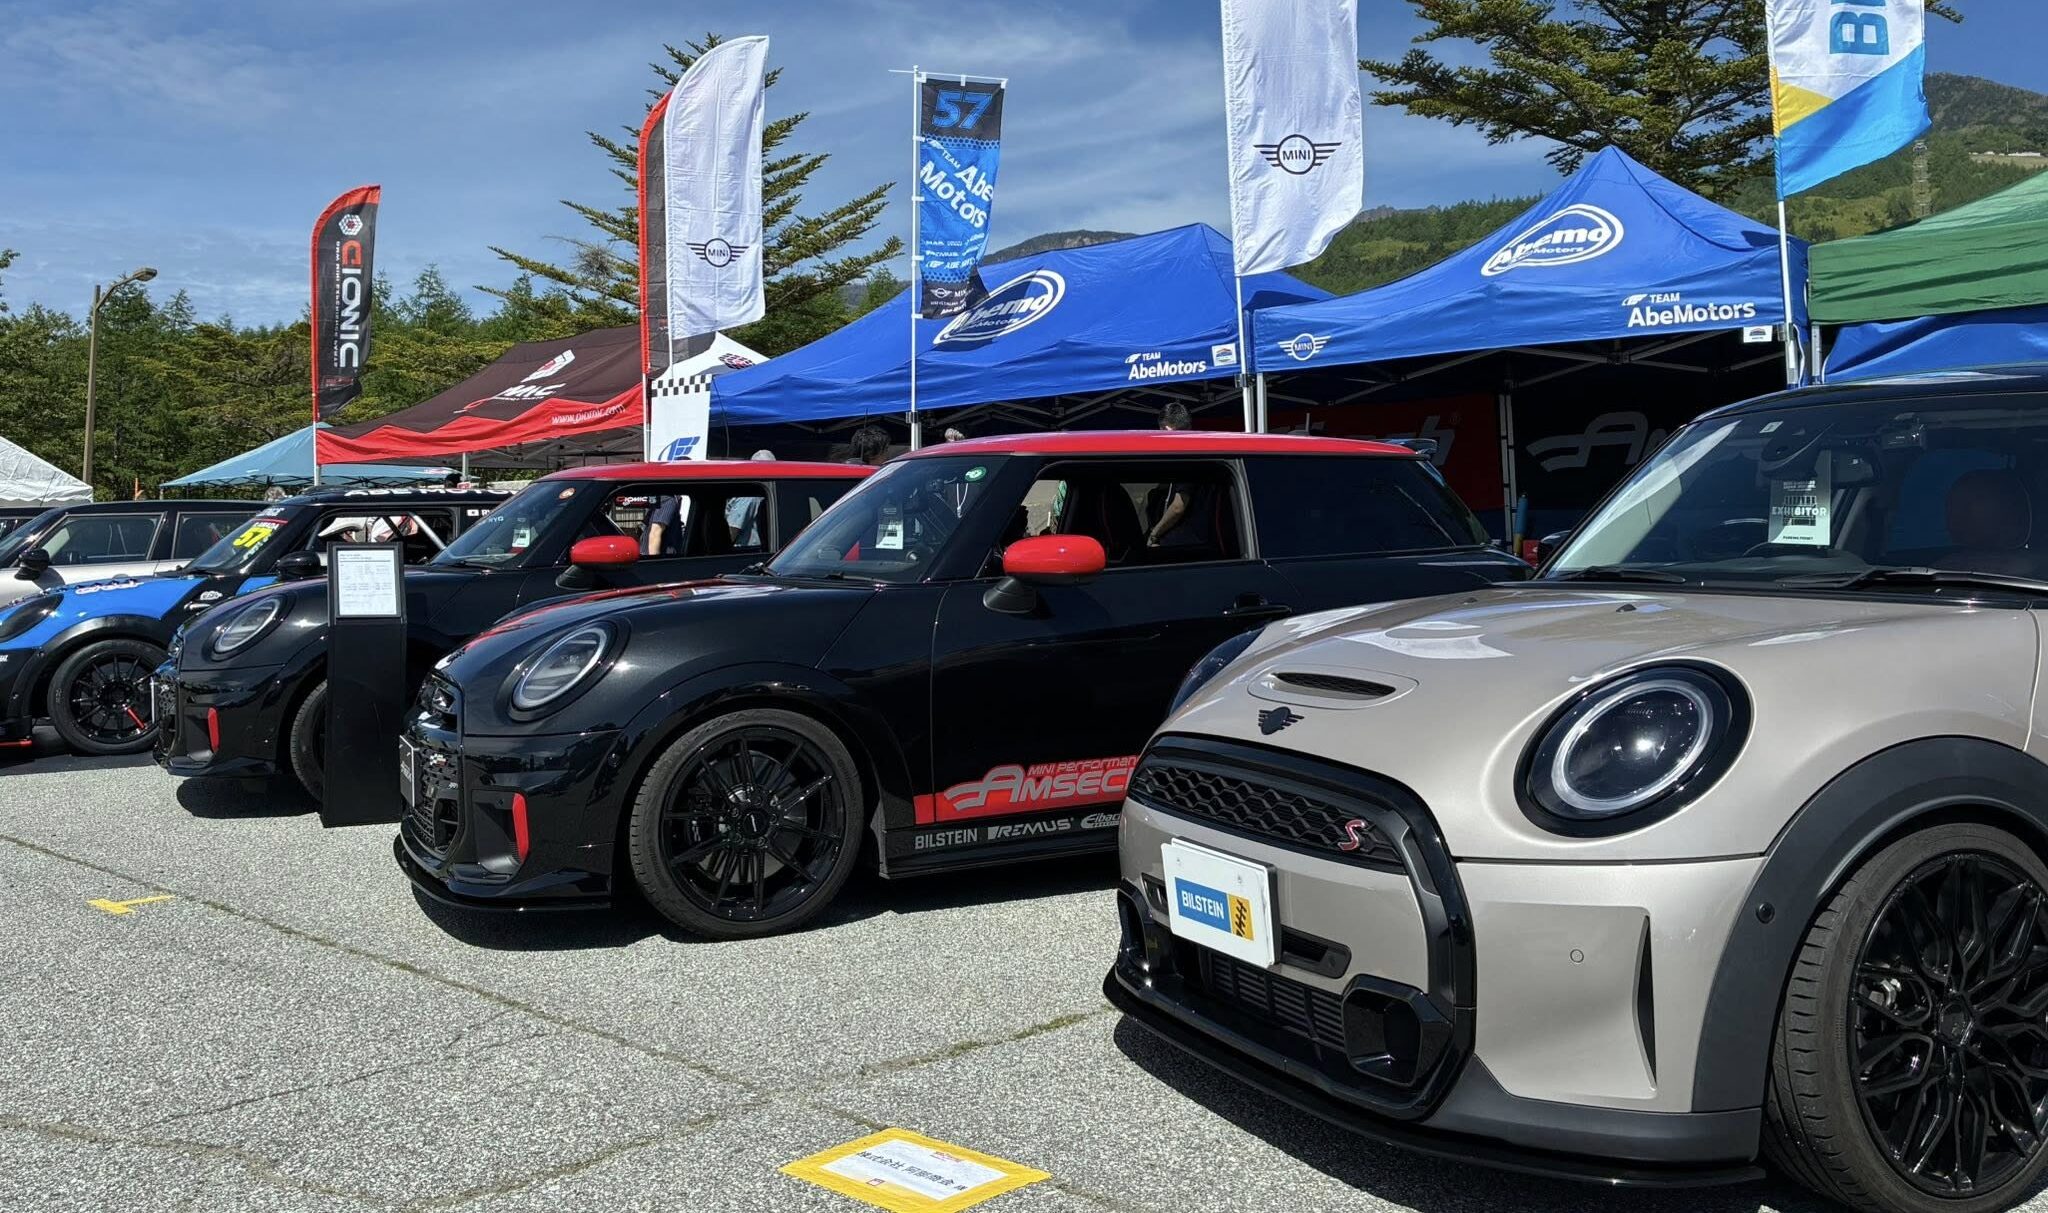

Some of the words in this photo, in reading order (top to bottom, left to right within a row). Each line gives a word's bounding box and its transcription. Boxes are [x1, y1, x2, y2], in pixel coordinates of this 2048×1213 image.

[932, 90, 993, 130] 57
[941, 150, 961, 169] TEAM
[1282, 149, 1311, 161] MINI
[920, 160, 988, 228] Motors
[954, 165, 994, 202] Abe
[707, 248, 729, 257] MINI
[1649, 292, 1681, 304] TEAM
[1627, 302, 1756, 328] AbeMotors
[1142, 351, 1161, 361] TEAM
[1294, 343, 1313, 352] MINI
[1128, 359, 1206, 381] AbeMotors
[1771, 506, 1827, 517] EXHIBITOR
[1028, 763, 1055, 777] MINI
[1057, 755, 1138, 773] Performan
[944, 764, 1134, 811] AMSEC
[915, 827, 978, 850] BILSTEIN
[1338, 819, 1366, 850] S
[1181, 889, 1225, 920] BILSTEIN
